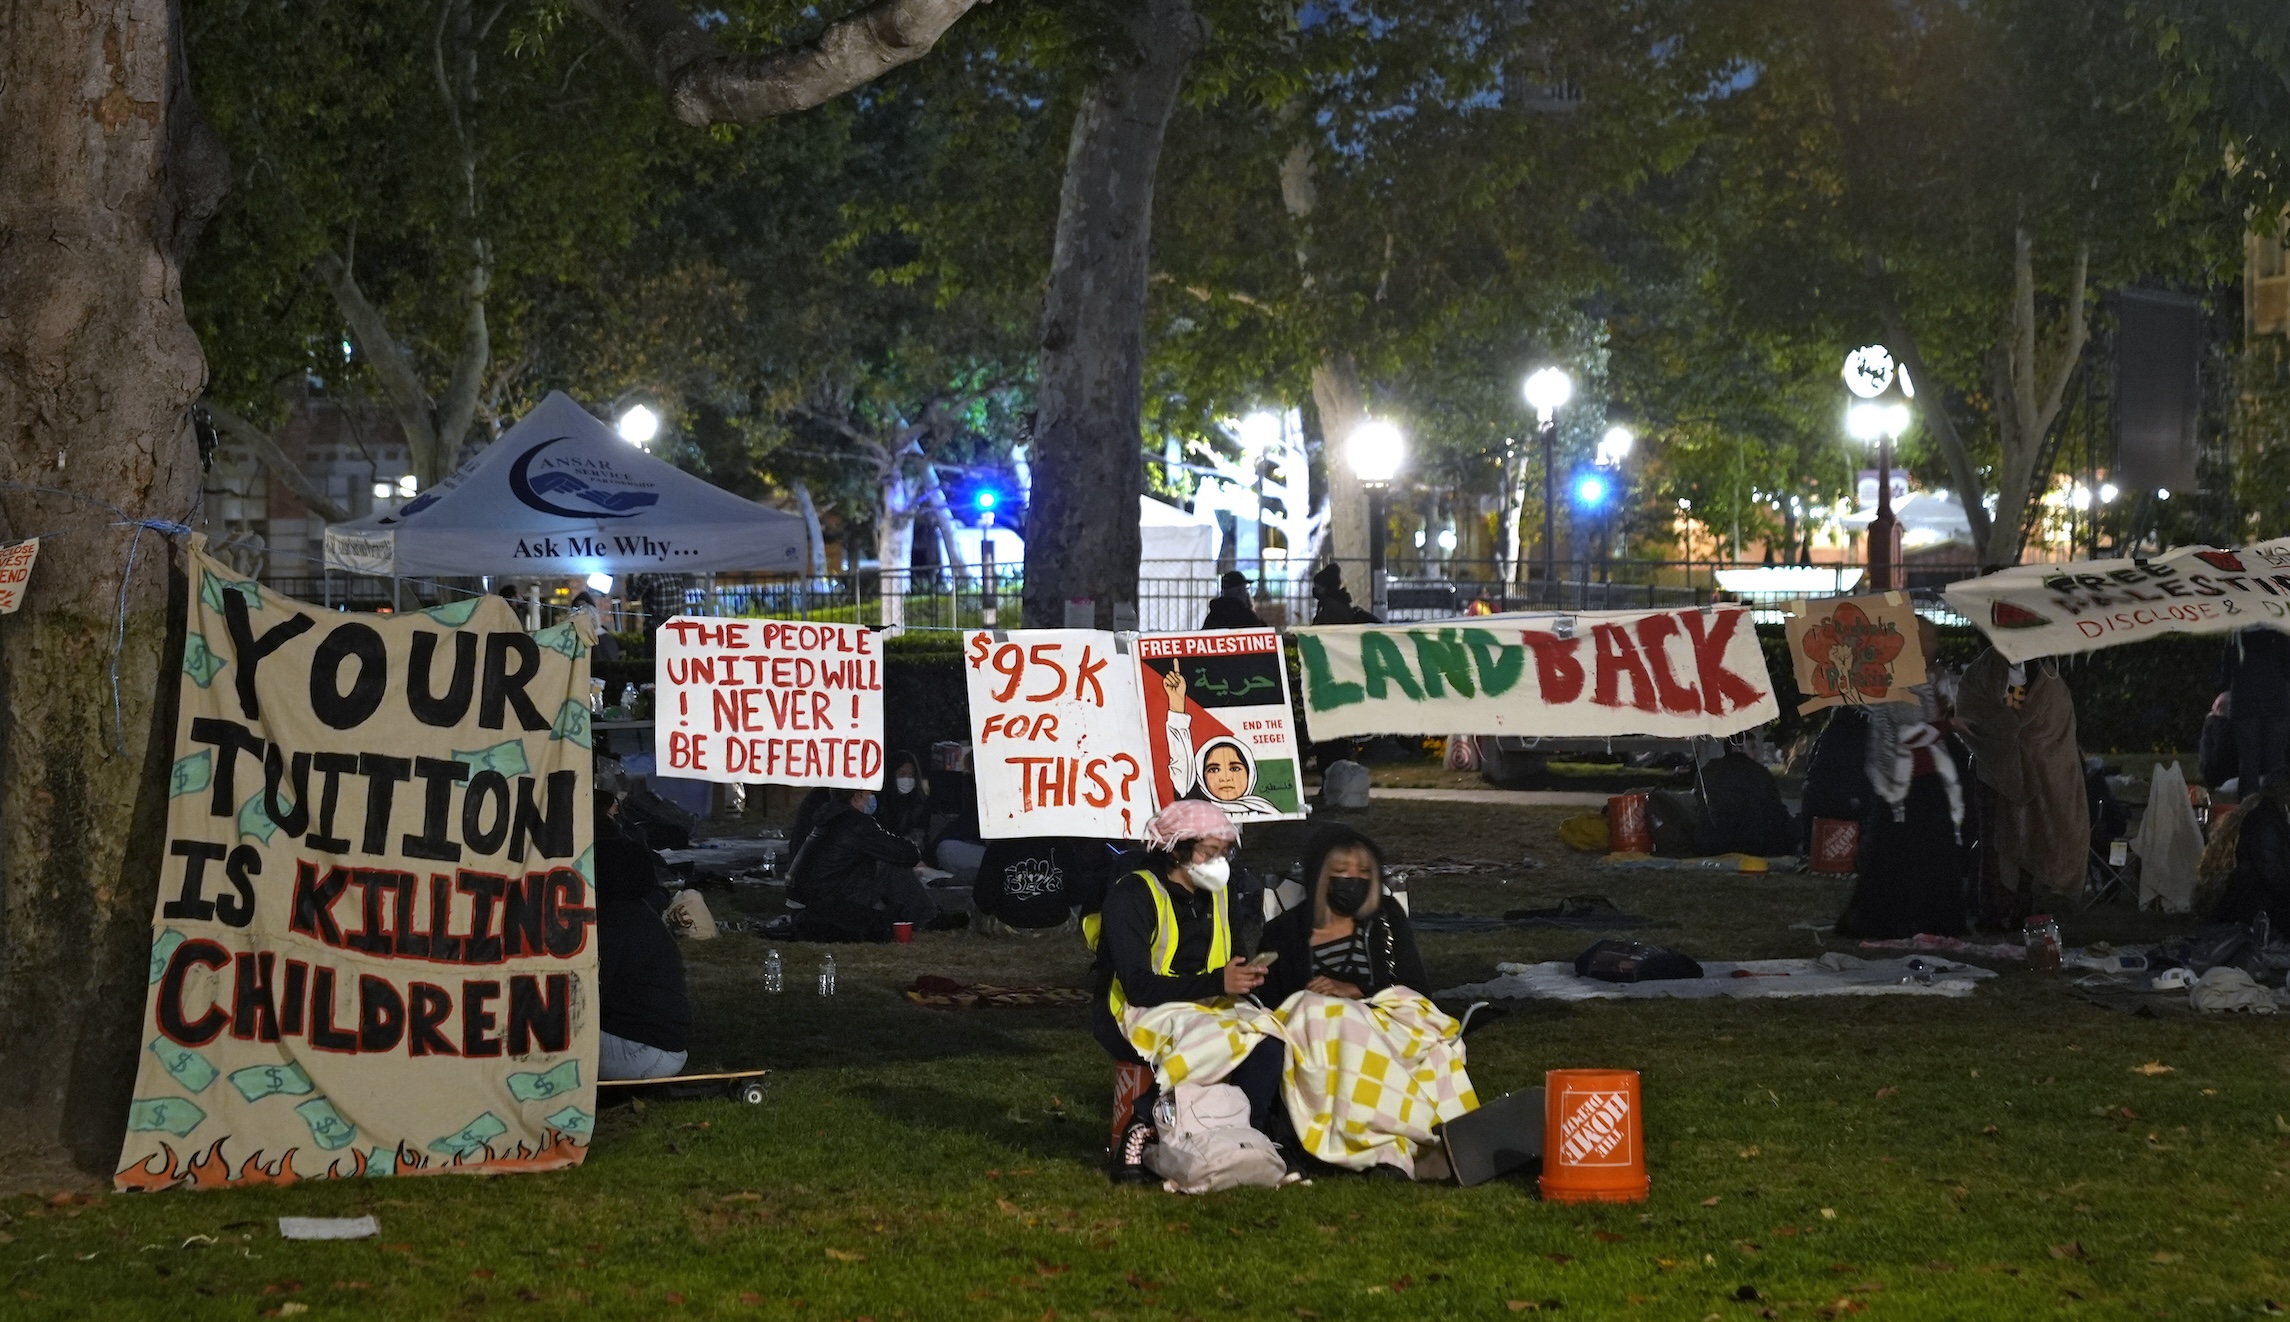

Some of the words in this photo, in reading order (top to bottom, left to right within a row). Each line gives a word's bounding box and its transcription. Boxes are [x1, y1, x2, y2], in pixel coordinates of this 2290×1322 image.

[540, 458, 612, 471] ANSAR
[575, 468, 633, 480] SERVICE
[513, 537, 560, 558] Ask
[568, 536, 607, 557] Me
[2043, 564, 2178, 594] FREE
[665, 619, 750, 649] THE
[763, 623, 872, 655] PEOPLE
[2077, 603, 2220, 639] DISCLOSE
[2222, 599, 2245, 615] &
[223, 588, 553, 731] YOUR
[1140, 639, 1183, 657] FREE
[1186, 634, 1276, 655] PALESTINE
[1299, 627, 1525, 712] LAND
[1519, 608, 1767, 718] BACK
[667, 655, 815, 688] UNITED
[821, 659, 882, 691] WILL
[1194, 666, 1276, 697] حرية
[713, 688, 834, 733] NEVER
[981, 713, 1059, 744] FOR
[1243, 720, 1262, 731] END
[1265, 719, 1283, 730] THE
[669, 731, 708, 770] BE
[725, 735, 882, 779] DEFEATED
[1253, 733, 1285, 745] SIEGE!
[191, 718, 577, 863] TUITION
[1005, 752, 1140, 840] THIS?
[1259, 779, 1294, 794] فلسطين
[162, 839, 262, 928] IS
[289, 857, 595, 965] KILLING
[156, 938, 572, 1060] CHILDREN
[1561, 1092, 1629, 1165] HOME
[1562, 1093, 1604, 1138] DEPOT
[1594, 1128, 1625, 1159] THE
